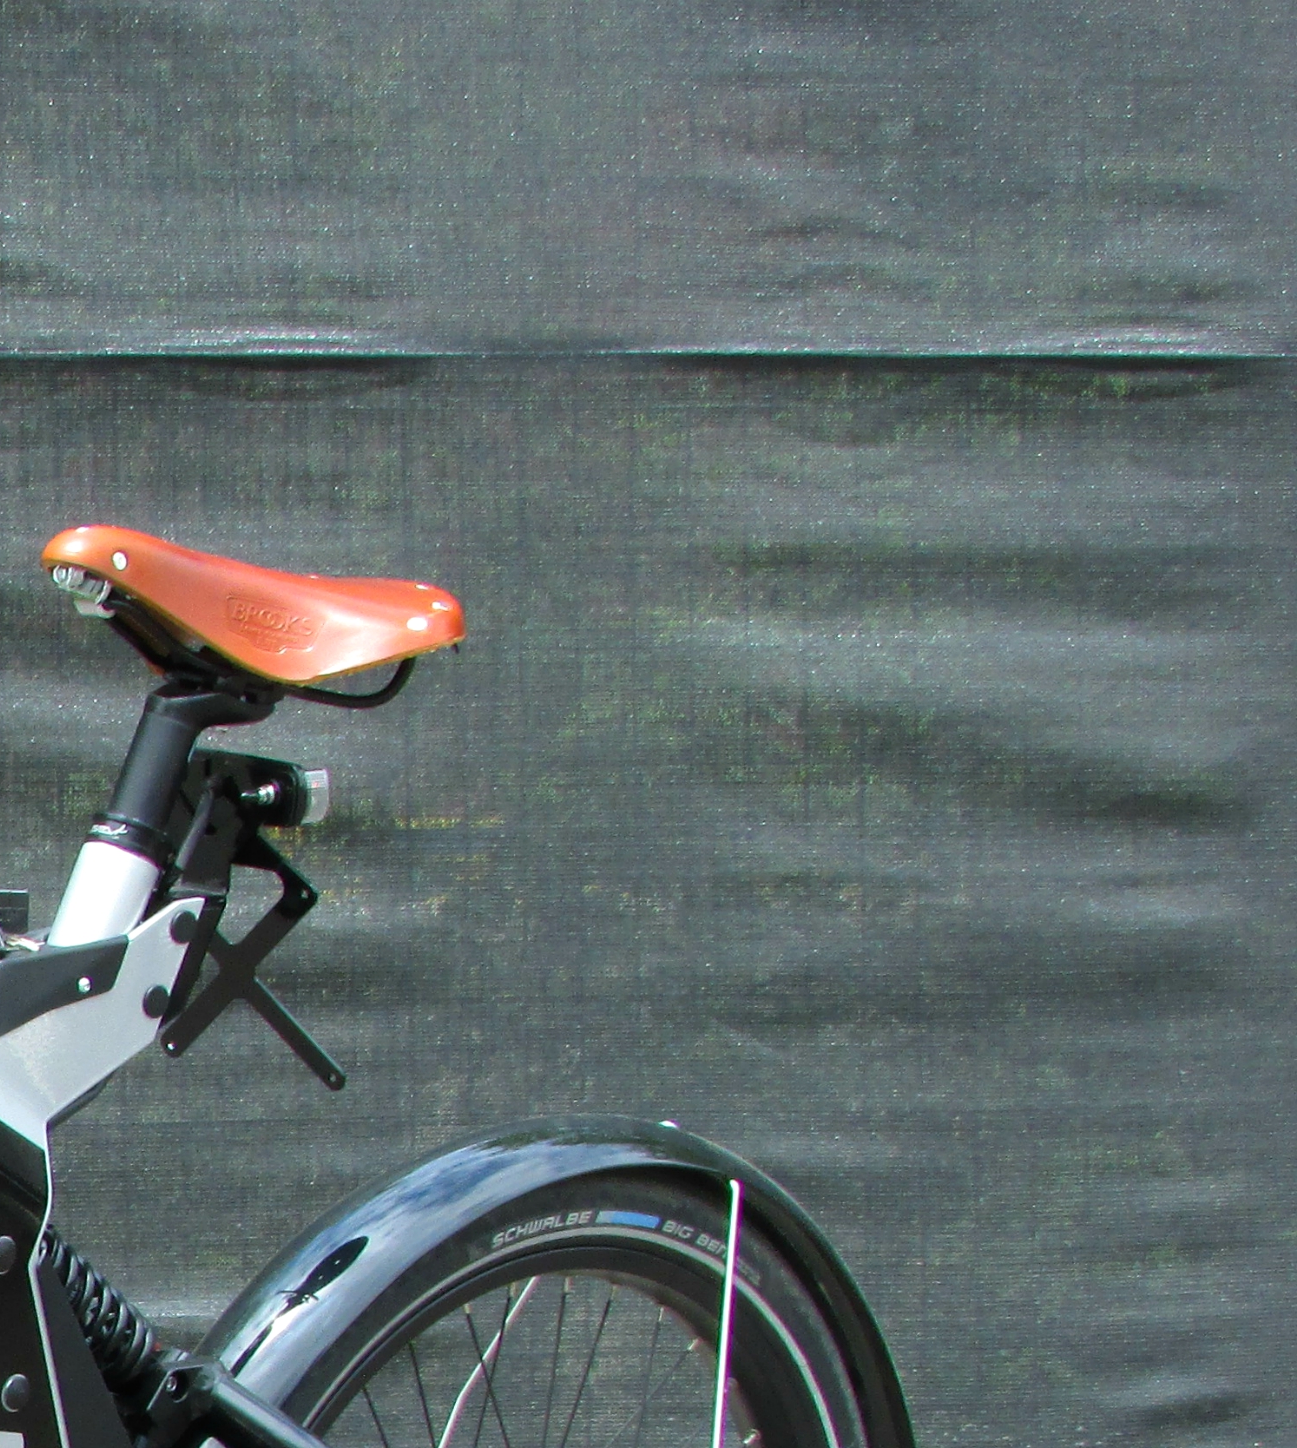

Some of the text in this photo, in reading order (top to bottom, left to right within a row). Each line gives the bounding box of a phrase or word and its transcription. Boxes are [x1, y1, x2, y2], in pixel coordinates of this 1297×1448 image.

[232, 603, 314, 636] BROOKS
[491, 1210, 593, 1249] SCHWALBE
[662, 1219, 695, 1239] BIG
